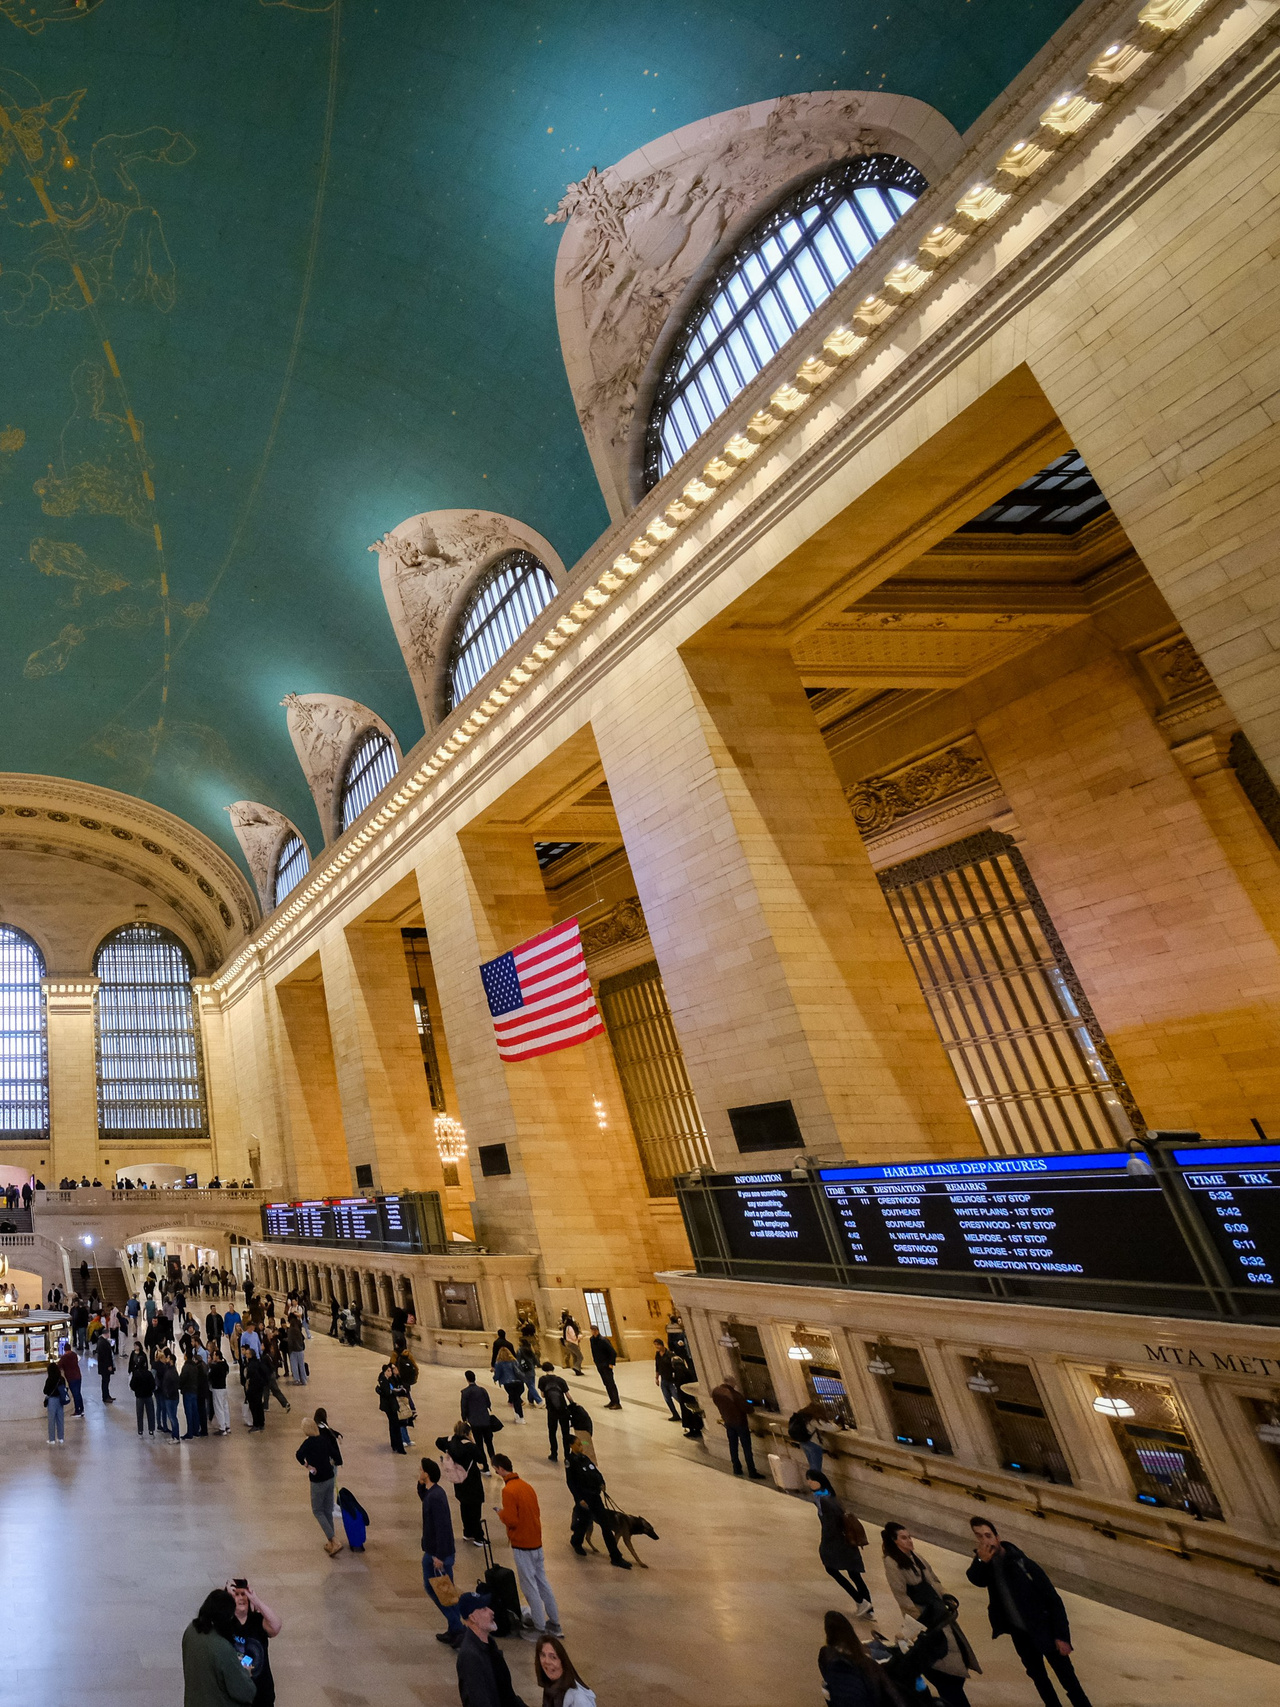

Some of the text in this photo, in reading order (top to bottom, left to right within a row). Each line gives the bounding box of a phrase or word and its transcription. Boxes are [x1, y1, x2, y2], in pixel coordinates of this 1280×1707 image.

[883, 1159, 1048, 1177] HARLEM LINE DEPARTURES
[734, 1174, 782, 1184] INFORMATION
[1189, 1173, 1272, 1186] TIME TRK
[827, 1182, 988, 1195] TIME TRK DESTINATION REMARKS
[878, 1197, 920, 1205] CRESTWOOD
[950, 1195, 988, 1203] MELROSE
[992, 1195, 1007, 1203] 1ST
[1008, 1194, 1031, 1202] STOP
[1208, 1191, 1234, 1200] 5:32
[881, 1208, 921, 1216] SOUTHEAST
[954, 1208, 980, 1216] WHITE
[980, 1208, 1009, 1216] PLAINS
[1014, 1208, 1029, 1216] 1ST
[1030, 1207, 1054, 1216] STOP
[1216, 1206, 1242, 1216] 5:42
[885, 1220, 925, 1228] SOUTHEAST
[959, 1221, 1010, 1229] CRESTWOOD
[1016, 1221, 1032, 1229] 1ST
[1032, 1221, 1056, 1230] STOP
[1223, 1223, 1249, 1233] 6:09
[897, 1232, 920, 1240] WHITE
[919, 1232, 945, 1241] PLAINS
[963, 1233, 1003, 1242] MELROSE
[1007, 1235, 1022, 1243] 1ST
[1023, 1235, 1048, 1244] STOP
[1232, 1239, 1256, 1250] 6:11
[893, 1244, 938, 1253] CRESTWOOD
[968, 1246, 1008, 1255] MELROSE
[1012, 1248, 1028, 1256] 1ST
[1029, 1248, 1053, 1257] STOP
[897, 1256, 938, 1266] SOUTHEAST
[973, 1259, 1028, 1270] CONNECTION
[1027, 1261, 1040, 1270] TO
[1040, 1262, 1084, 1272] WASSAIC
[1239, 1255, 1266, 1266] 6:32
[1247, 1272, 1274, 1284] 6:42
[1143, 1343, 1280, 1376] MTA MET
